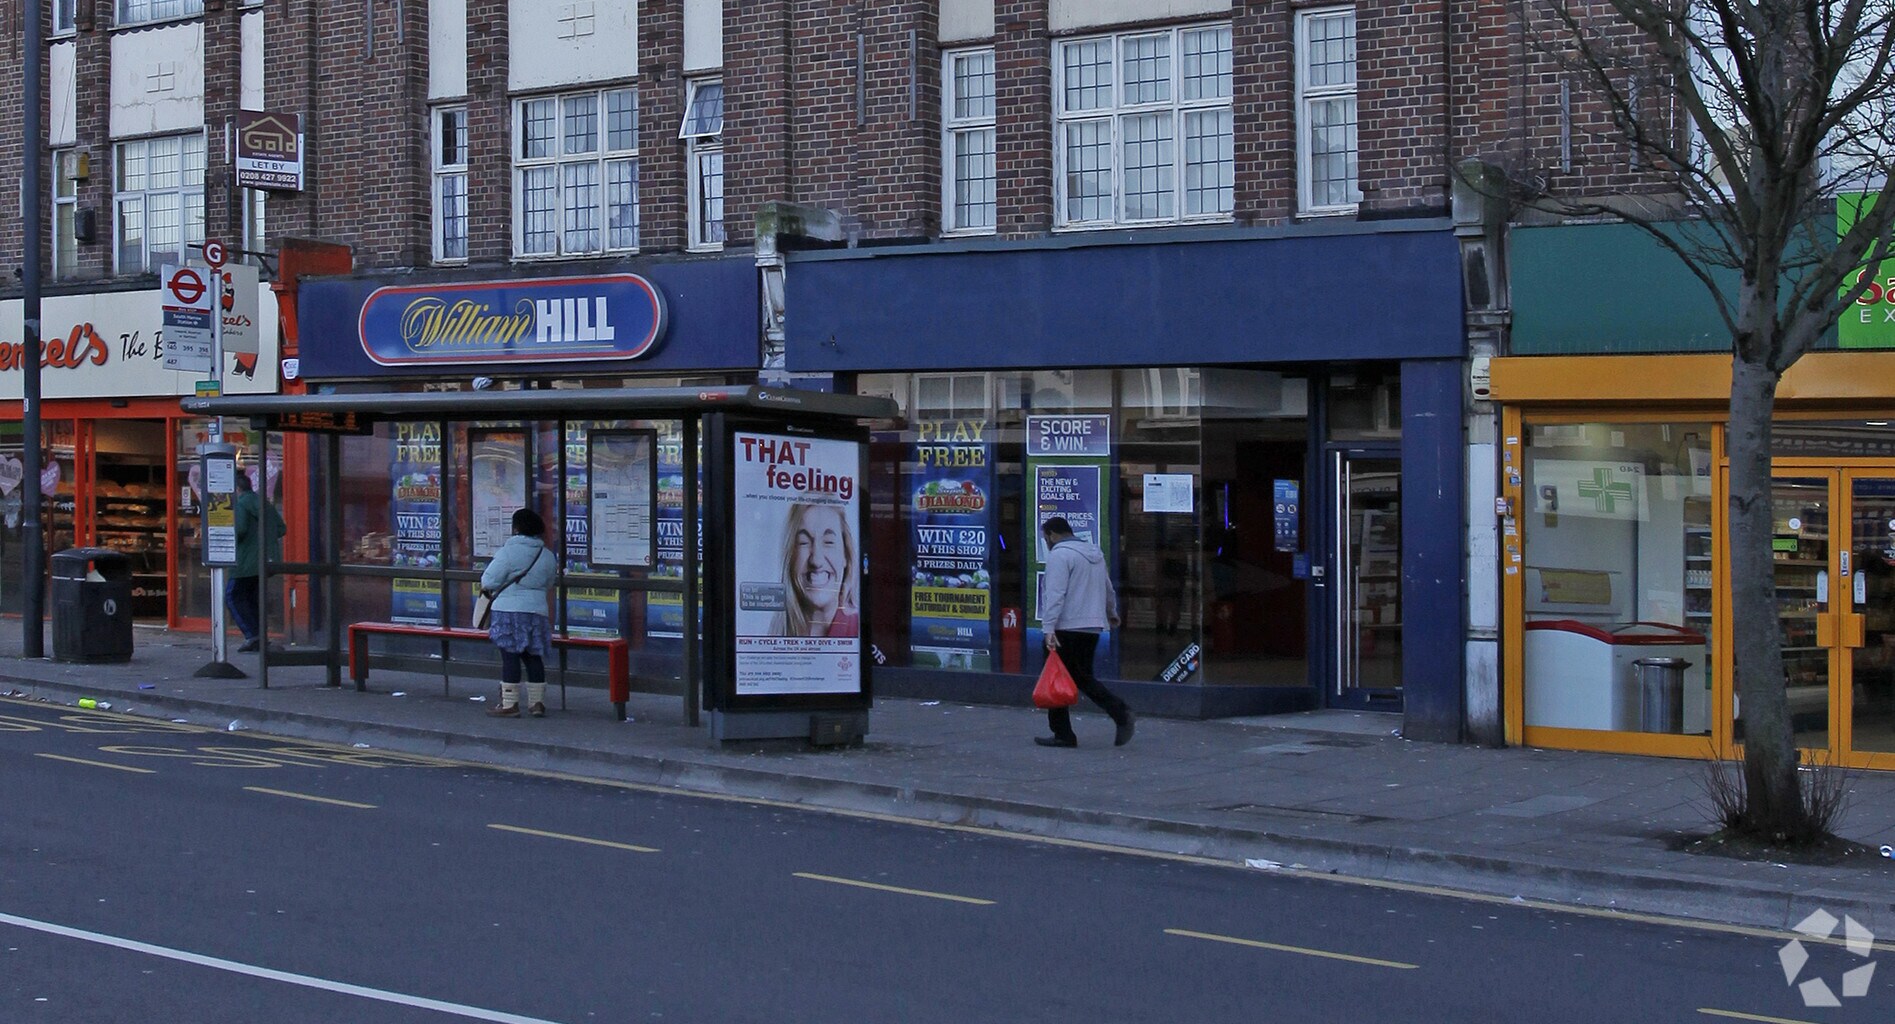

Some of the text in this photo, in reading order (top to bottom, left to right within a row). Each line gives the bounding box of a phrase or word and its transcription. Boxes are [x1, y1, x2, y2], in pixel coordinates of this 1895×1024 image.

[251, 161, 285, 170] LET BY
[240, 171, 297, 183] 0208 427 9922
[206, 243, 222, 263] G
[401, 296, 615, 349] William HILL
[120, 330, 149, 362] The
[917, 419, 987, 442] PLAY
[1040, 420, 1092, 435] SCORE
[1041, 436, 1088, 451] & WIN.
[740, 437, 811, 466] THAT
[917, 445, 986, 467] FREE
[766, 464, 853, 499] feeling
[1041, 478, 1054, 486] THE
[1055, 478, 1072, 486] NEW
[918, 494, 985, 510] DIAMOND
[1041, 493, 1081, 501] GOALS BET.
[397, 516, 442, 529] WIN £2
[407, 530, 425, 538] THIS
[426, 530, 442, 539] SHO
[917, 529, 986, 545] WIN £20
[917, 544, 985, 555] IN THIS SHOP
[924, 560, 956, 569] PRIZES
[957, 561, 984, 570] DAILY
[914, 592, 986, 604] FREE TOURNAMENT
[914, 602, 951, 613] SATURDAY
[959, 604, 986, 614] SUNDAY
[957, 626, 973, 637] HILL
[1162, 645, 1200, 682] DEBIT CARD
